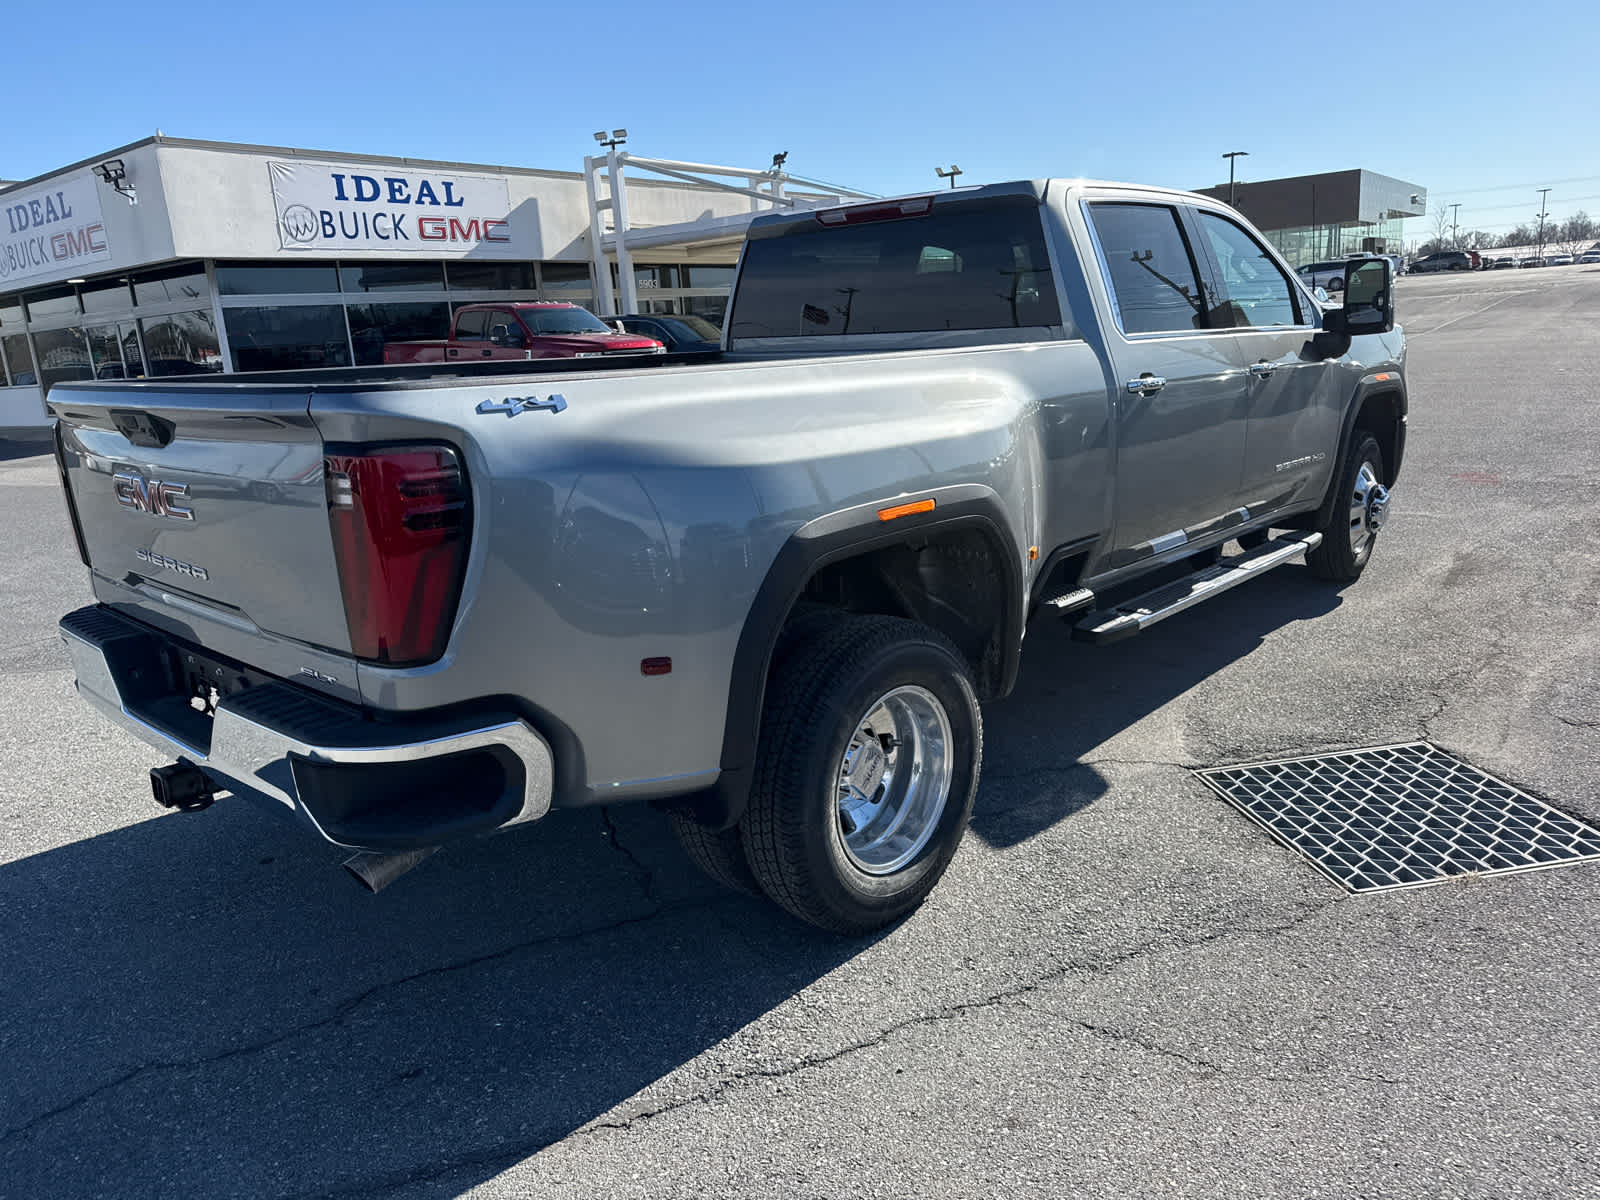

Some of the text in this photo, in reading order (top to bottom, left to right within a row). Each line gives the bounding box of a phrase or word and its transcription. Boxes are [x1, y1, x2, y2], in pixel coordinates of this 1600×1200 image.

[331, 174, 464, 207] IDEAL
[6, 192, 72, 233] IDEAL
[320, 210, 512, 242] BUICK GMC
[7, 223, 107, 271] BUICK GMC
[112, 472, 195, 521] GMC
[135, 548, 209, 581] SIERRA
